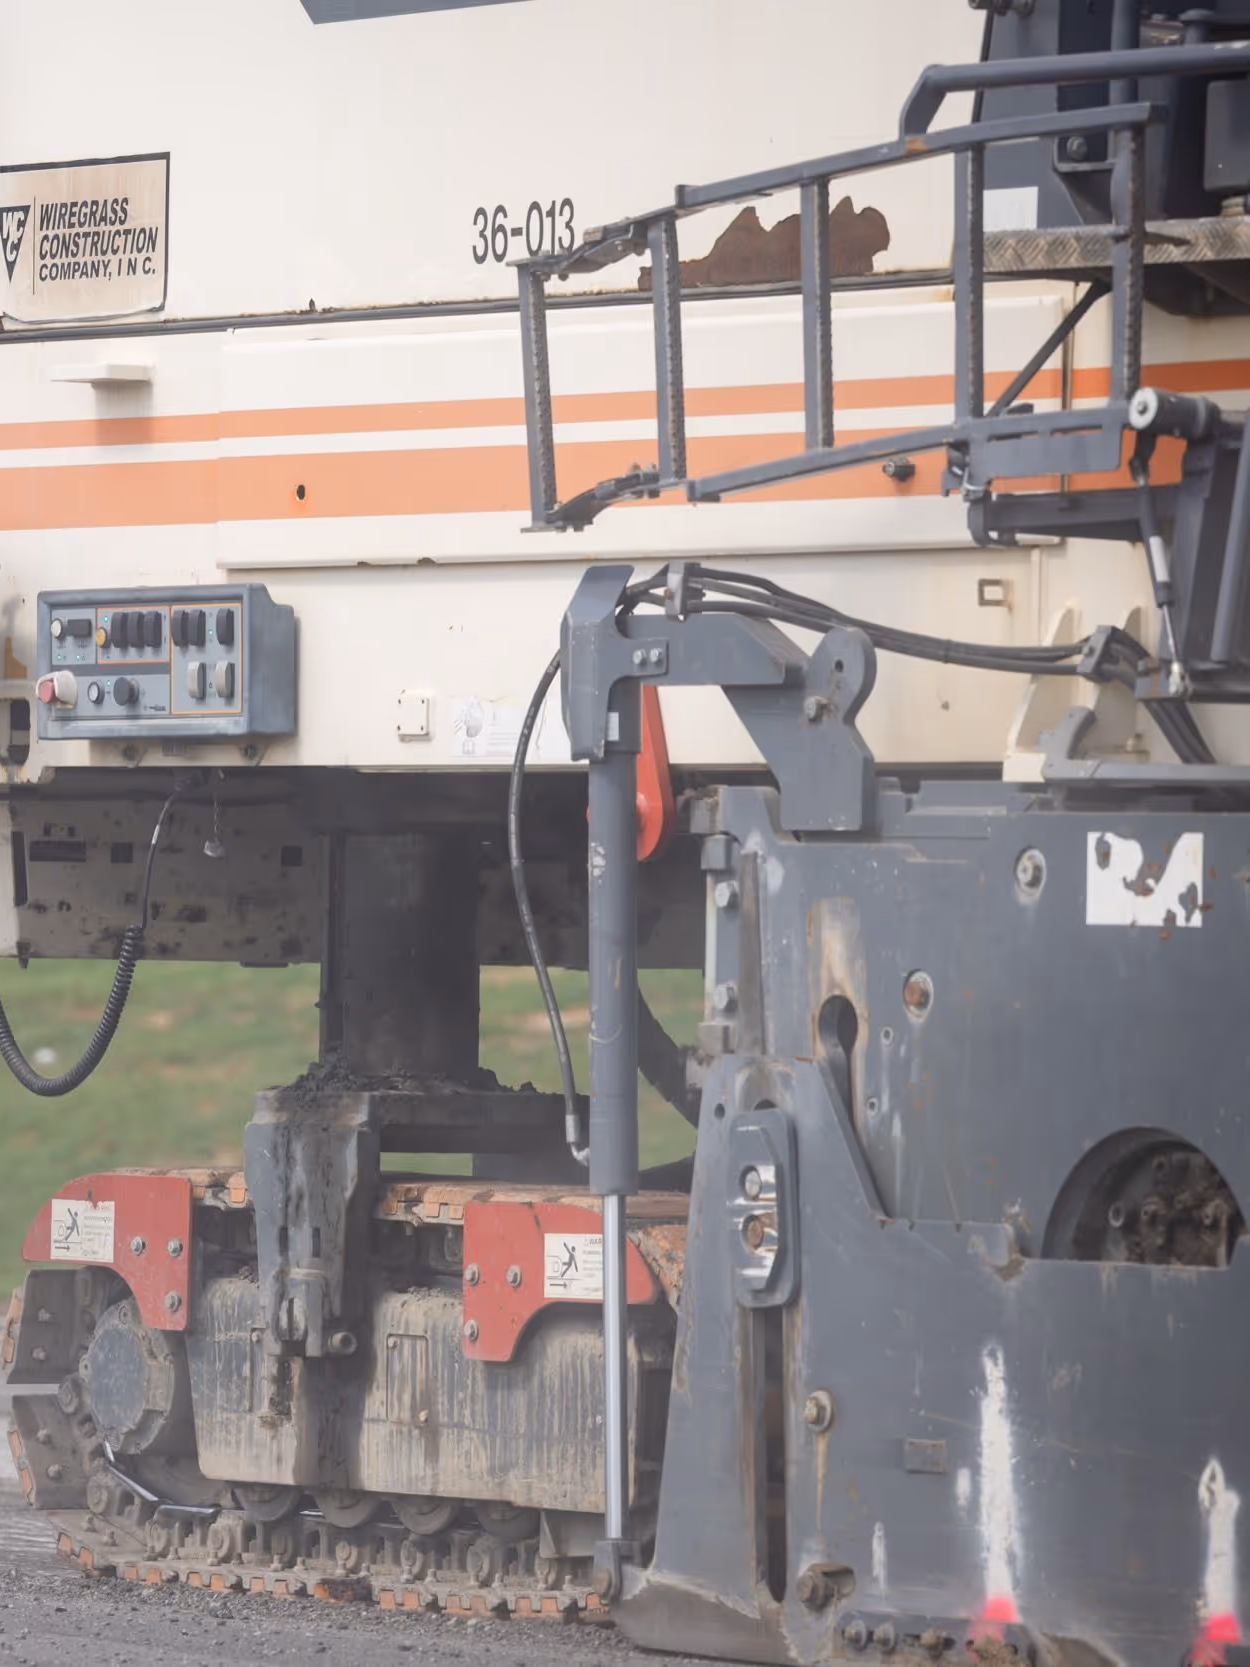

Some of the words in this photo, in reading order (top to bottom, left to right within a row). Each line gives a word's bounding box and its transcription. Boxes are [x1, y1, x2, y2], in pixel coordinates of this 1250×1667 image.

[39, 197, 129, 231] WIREGRASS
[39, 227, 159, 260] CONSTRUCTION
[472, 197, 575, 265] 36-013
[39, 259, 112, 281] COMPANY,
